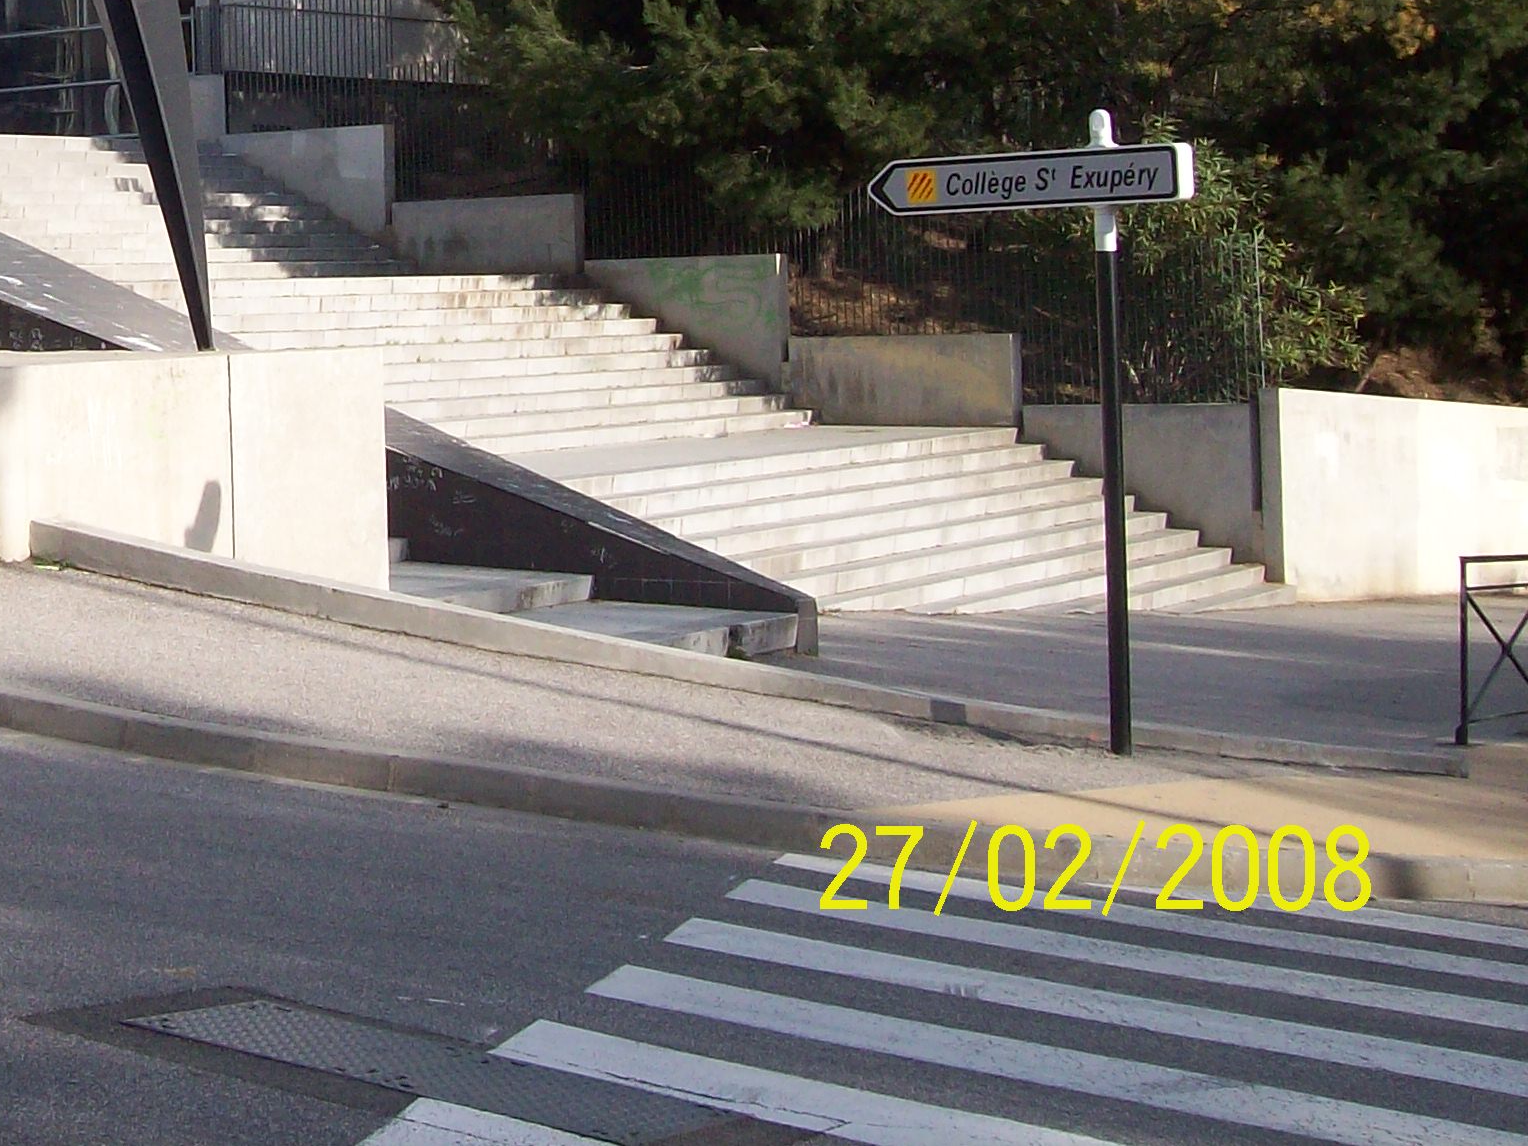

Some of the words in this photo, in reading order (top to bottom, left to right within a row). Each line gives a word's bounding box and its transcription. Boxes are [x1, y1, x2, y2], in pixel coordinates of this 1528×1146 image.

[946, 170, 1027, 200] Collège
[1035, 166, 1057, 192] St
[1070, 162, 1160, 194] Exupéry
